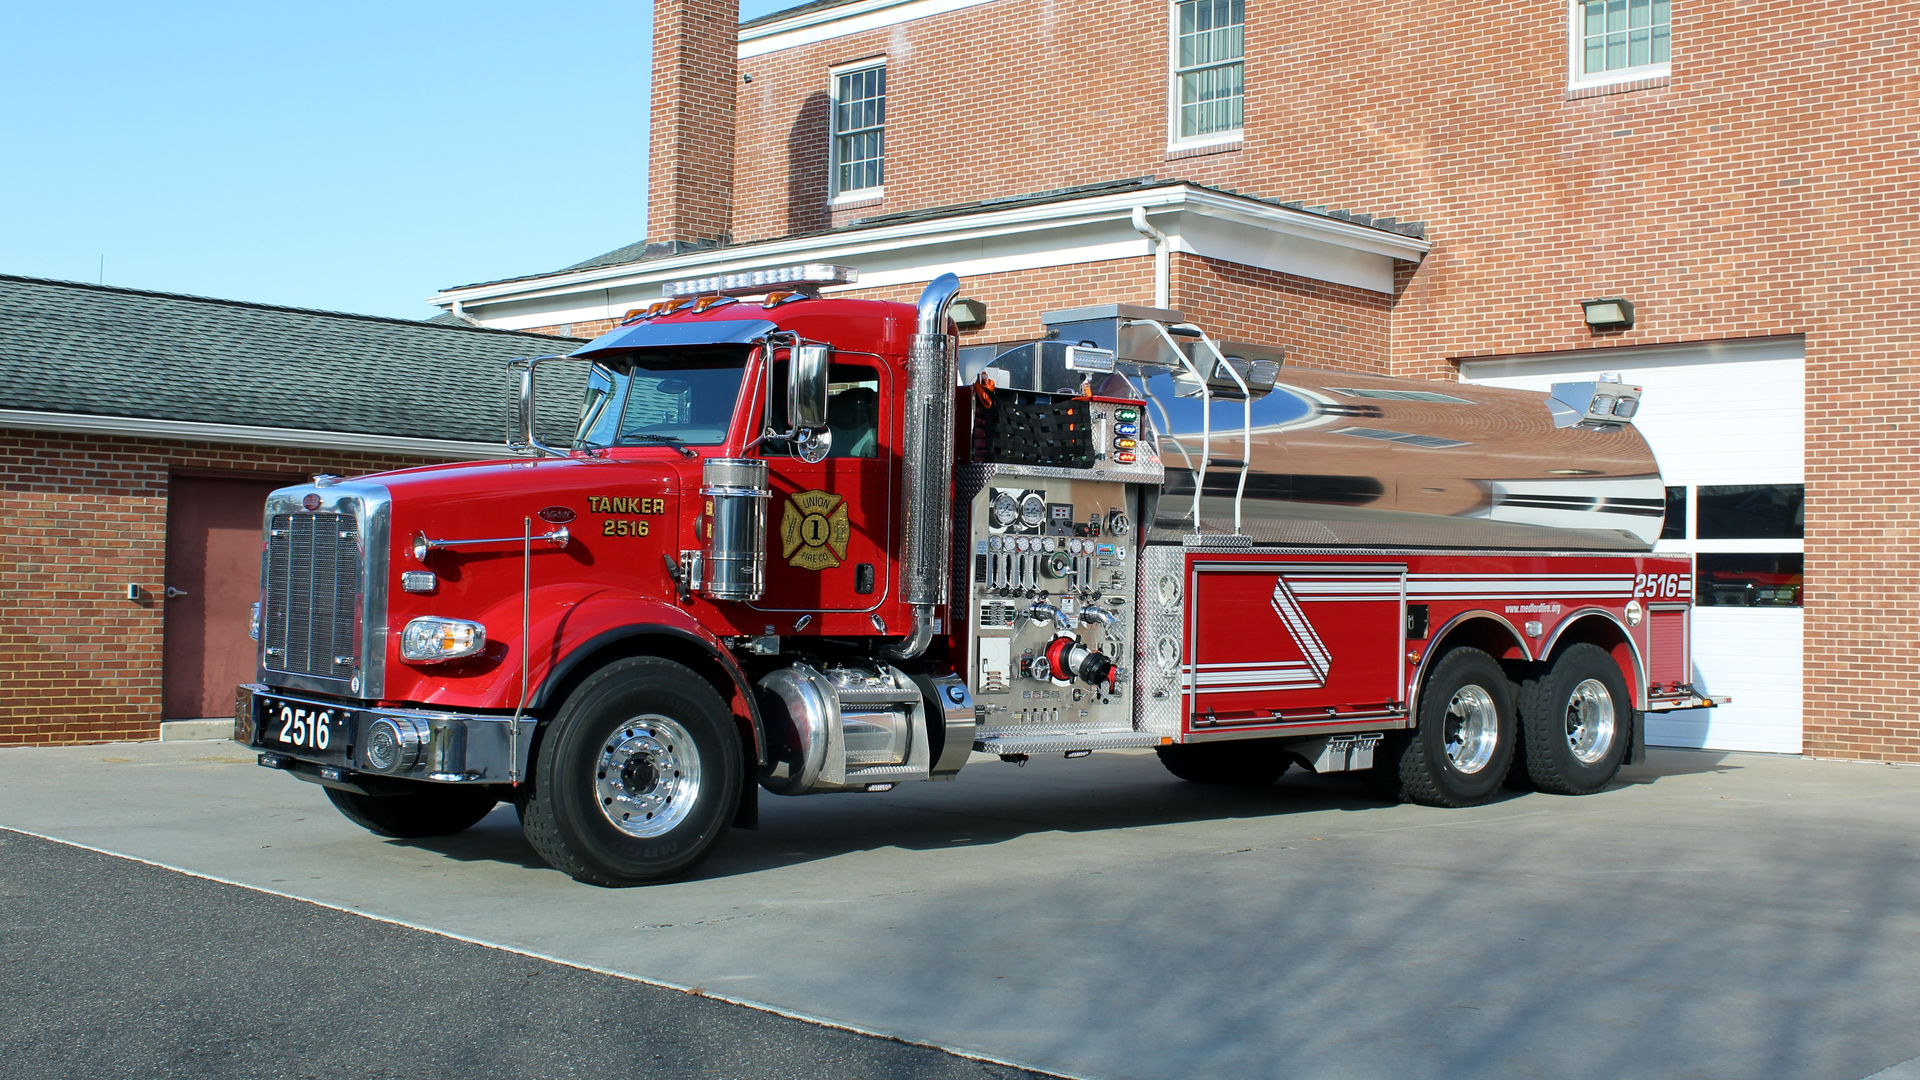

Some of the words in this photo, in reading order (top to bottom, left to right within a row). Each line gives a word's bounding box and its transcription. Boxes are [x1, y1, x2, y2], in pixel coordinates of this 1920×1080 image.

[587, 496, 665, 515] TANKER
[802, 497, 830, 509] UNION
[603, 519, 650, 537] 2516
[811, 520, 820, 540] 1
[801, 551, 817, 563] FIRE
[1633, 573, 1679, 598] 2516
[1504, 602, 1561, 615] www.medfordfire.org
[278, 706, 330, 750] 2516
